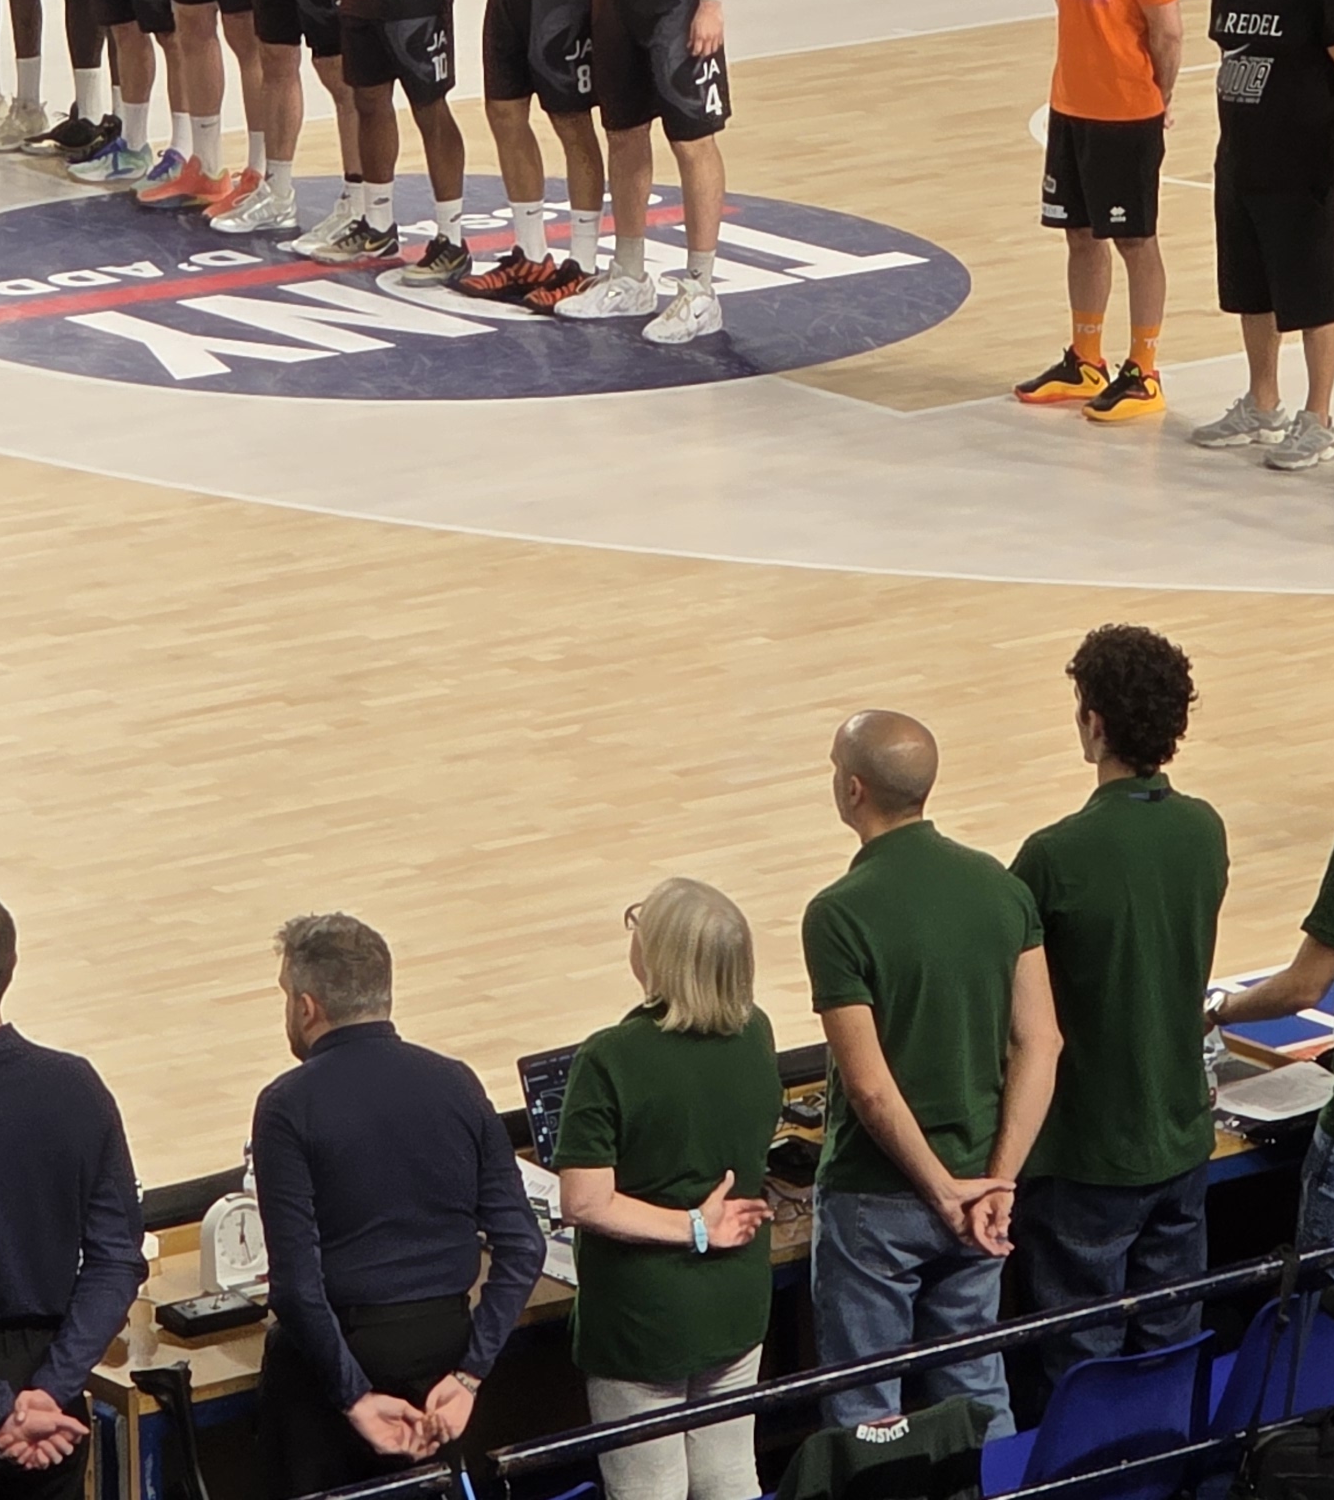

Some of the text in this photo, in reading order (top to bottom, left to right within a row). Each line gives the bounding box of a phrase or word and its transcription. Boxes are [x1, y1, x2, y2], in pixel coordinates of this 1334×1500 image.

[1223, 11, 1284, 38] REDEL
[576, 63, 592, 95] 8
[705, 82, 723, 116] 4
[856, 1417, 911, 1445] BASKET
